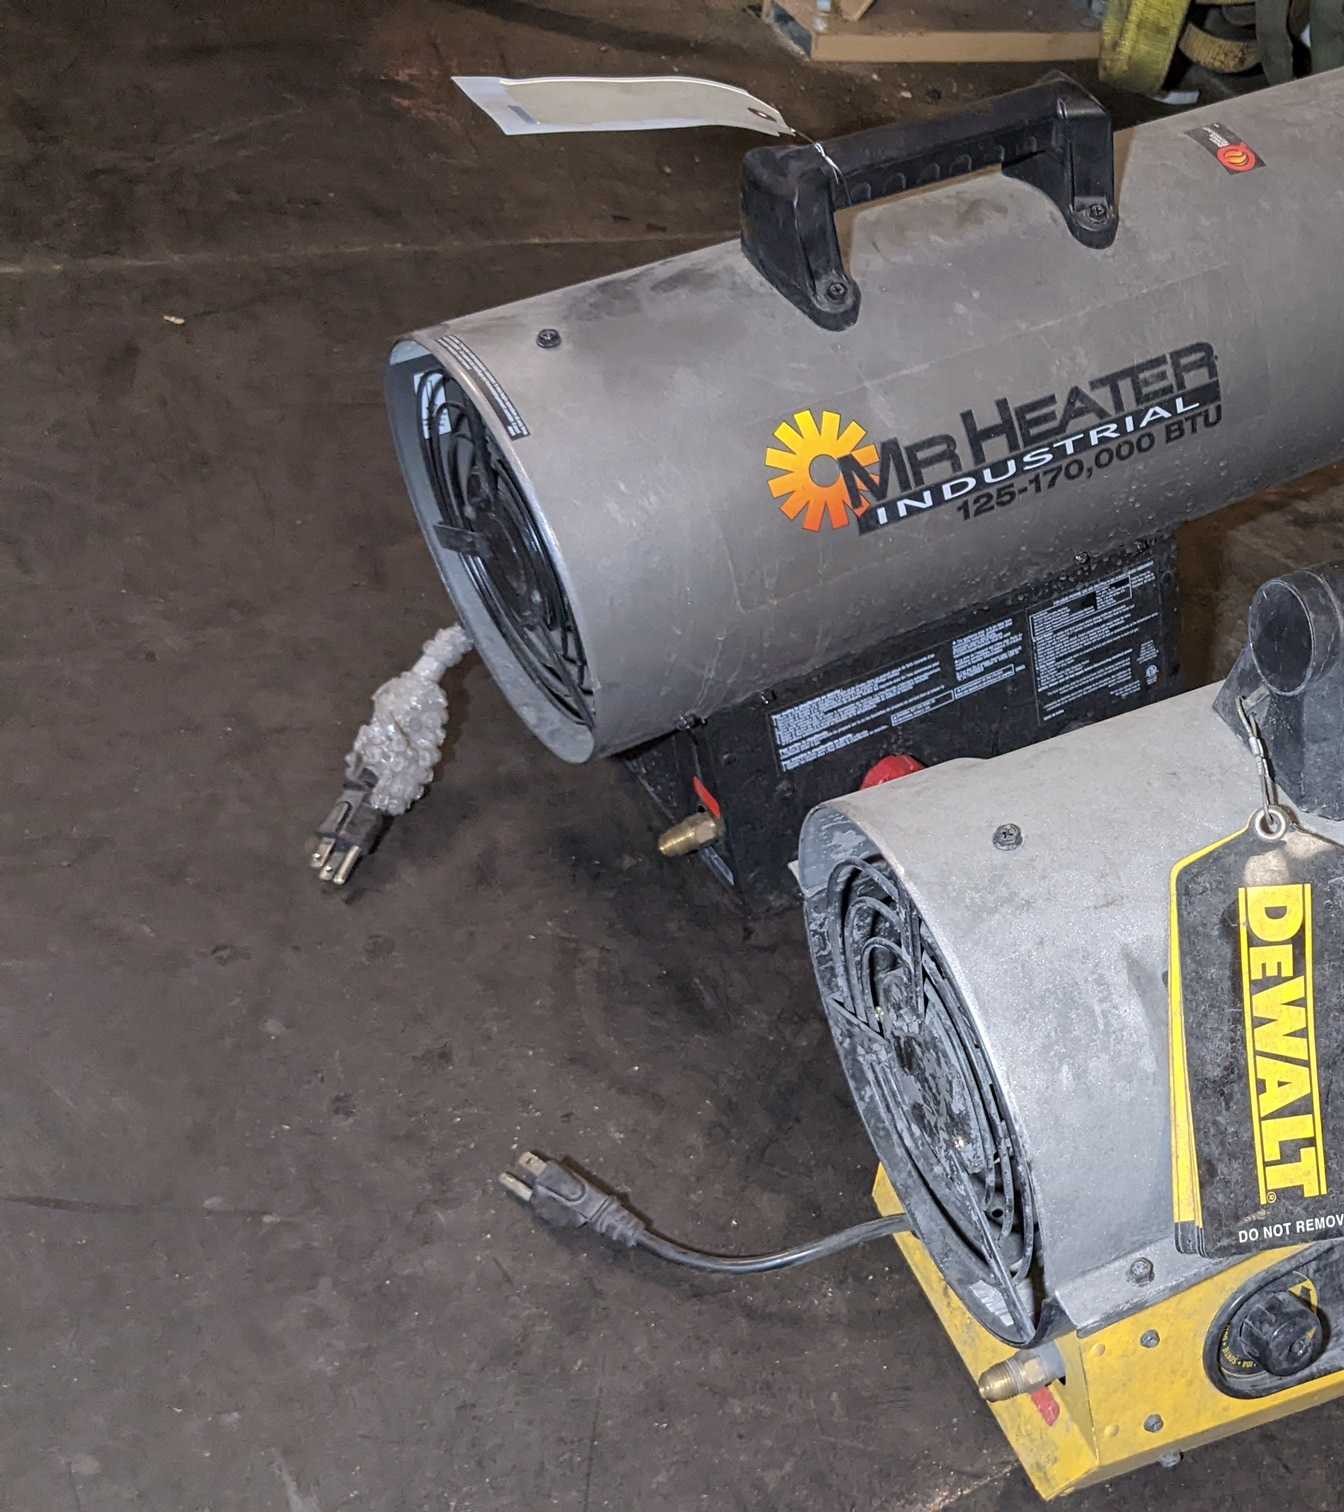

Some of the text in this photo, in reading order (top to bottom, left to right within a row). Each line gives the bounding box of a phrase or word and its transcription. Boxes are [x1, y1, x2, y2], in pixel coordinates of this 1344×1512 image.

[837, 341, 1221, 510] MR HEATER
[876, 396, 1200, 525] INDUSTRIAL
[956, 403, 1223, 522] 125-170,000 BTU
[1244, 887, 1321, 1198] DEWALT
[1238, 1227, 1262, 1244] DO
[1263, 1222, 1293, 1240] NOT
